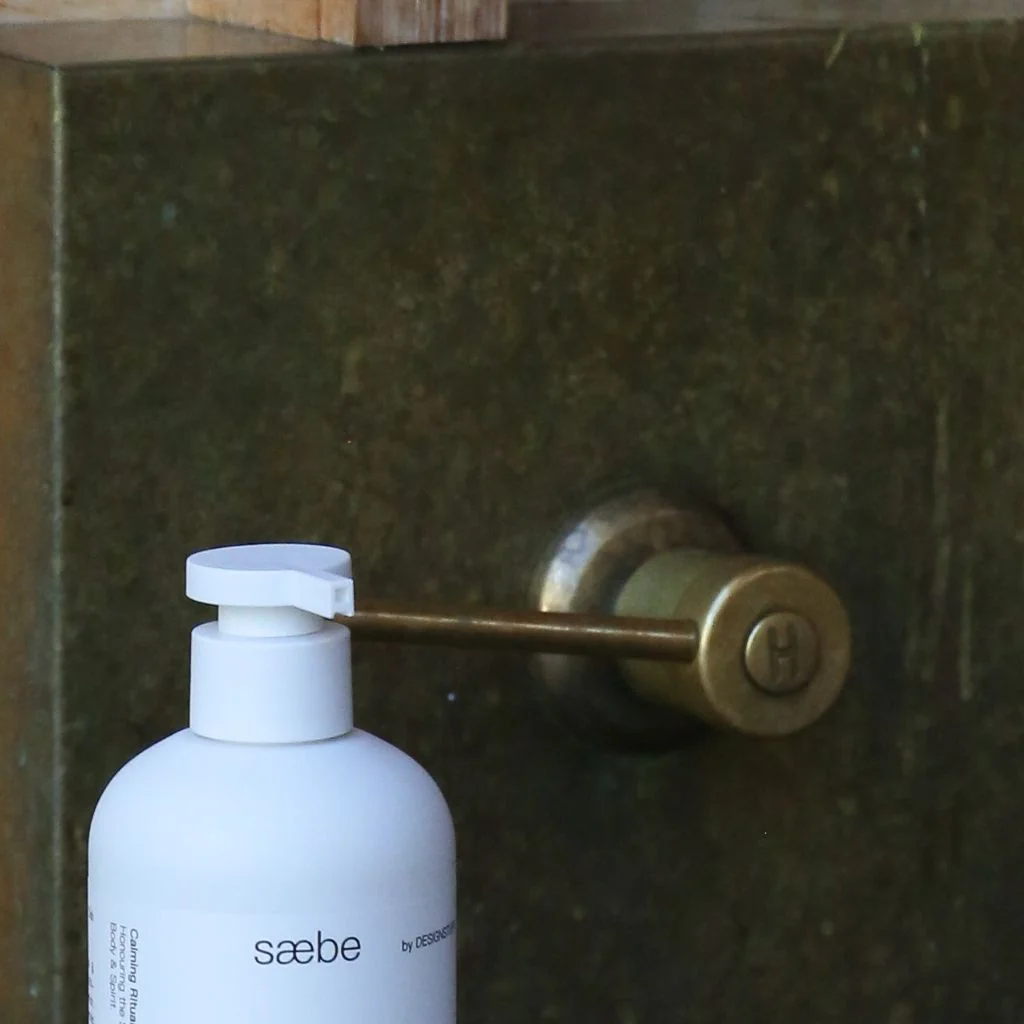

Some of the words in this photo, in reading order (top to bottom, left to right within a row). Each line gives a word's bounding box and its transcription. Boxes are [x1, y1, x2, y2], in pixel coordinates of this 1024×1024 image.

[109, 921, 117, 956] Body
[128, 928, 139, 984] Calming
[254, 930, 361, 965] sæbe
[401, 940, 413, 953] by
[110, 960, 118, 969] &
[117, 924, 127, 992] Honouring
